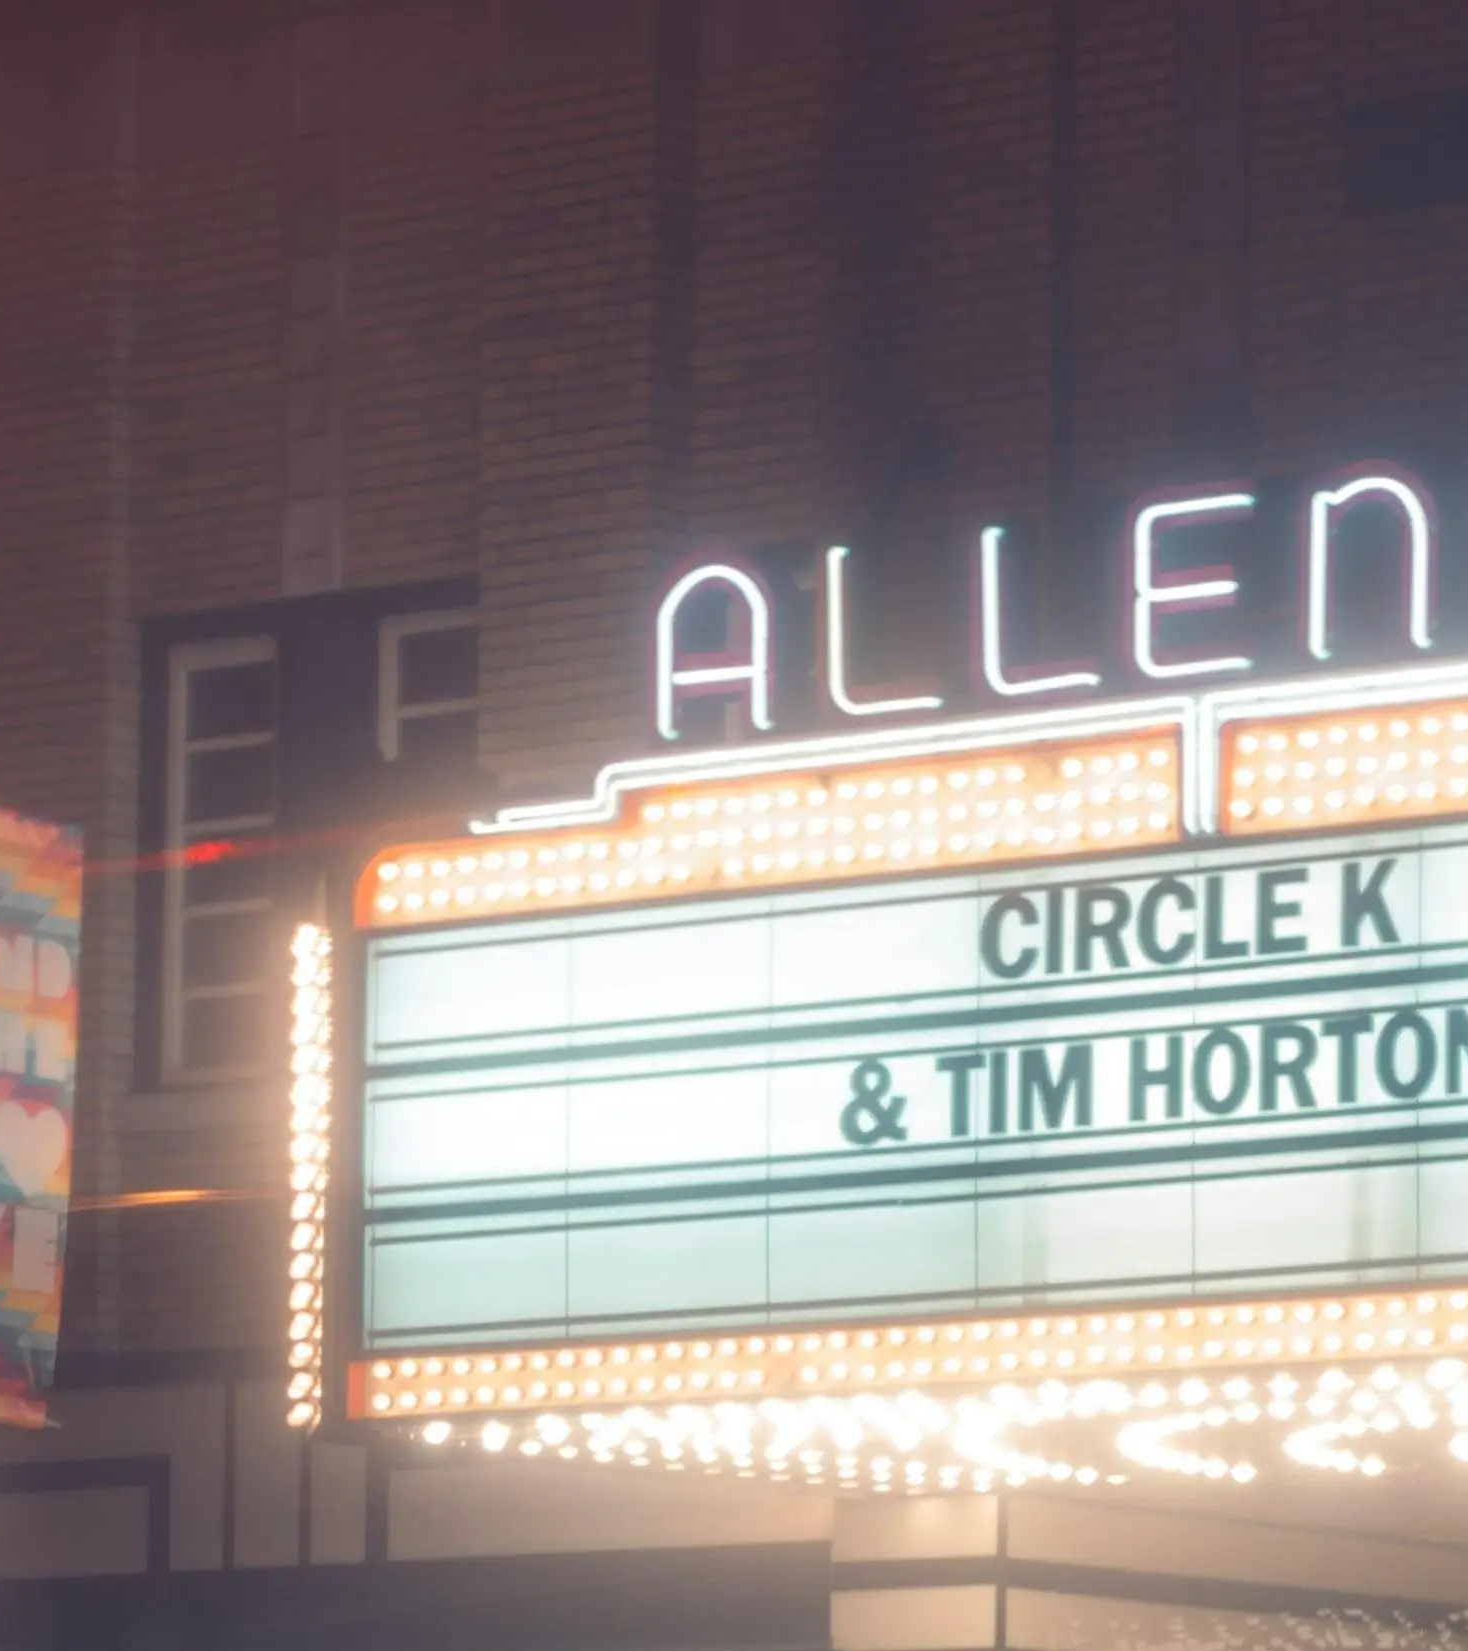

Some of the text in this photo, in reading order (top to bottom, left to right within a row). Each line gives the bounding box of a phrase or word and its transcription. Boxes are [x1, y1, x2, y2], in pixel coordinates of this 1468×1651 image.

[978, 857, 1402, 981] CIRCLE K
[838, 1054, 908, 1147] &
[936, 1040, 1095, 1139] TIM
